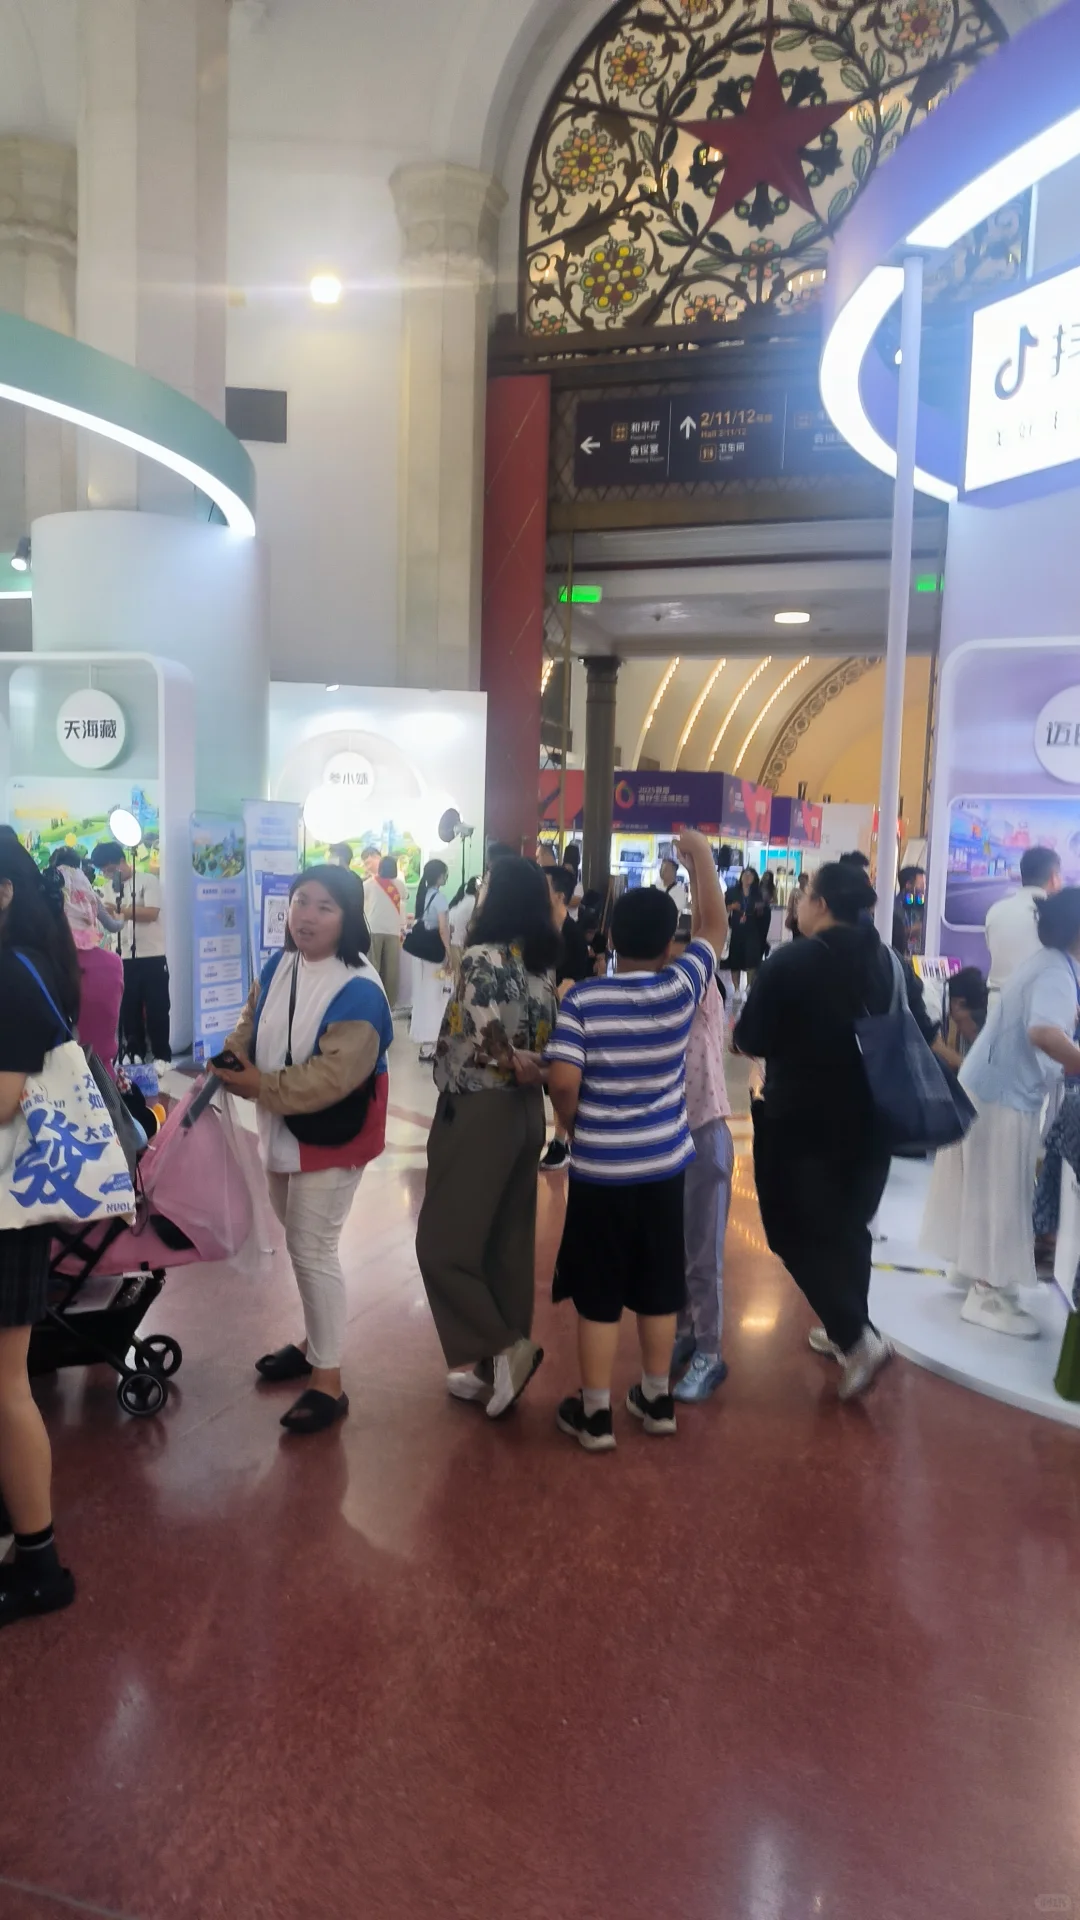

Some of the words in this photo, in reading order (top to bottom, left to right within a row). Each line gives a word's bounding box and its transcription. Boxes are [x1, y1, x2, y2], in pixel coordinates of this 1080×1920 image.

[631, 420, 661, 433] 和平厅
[630, 443, 659, 456] 会议室
[720, 442, 745, 453] 卫生间
[64, 719, 117, 740] 天海藏
